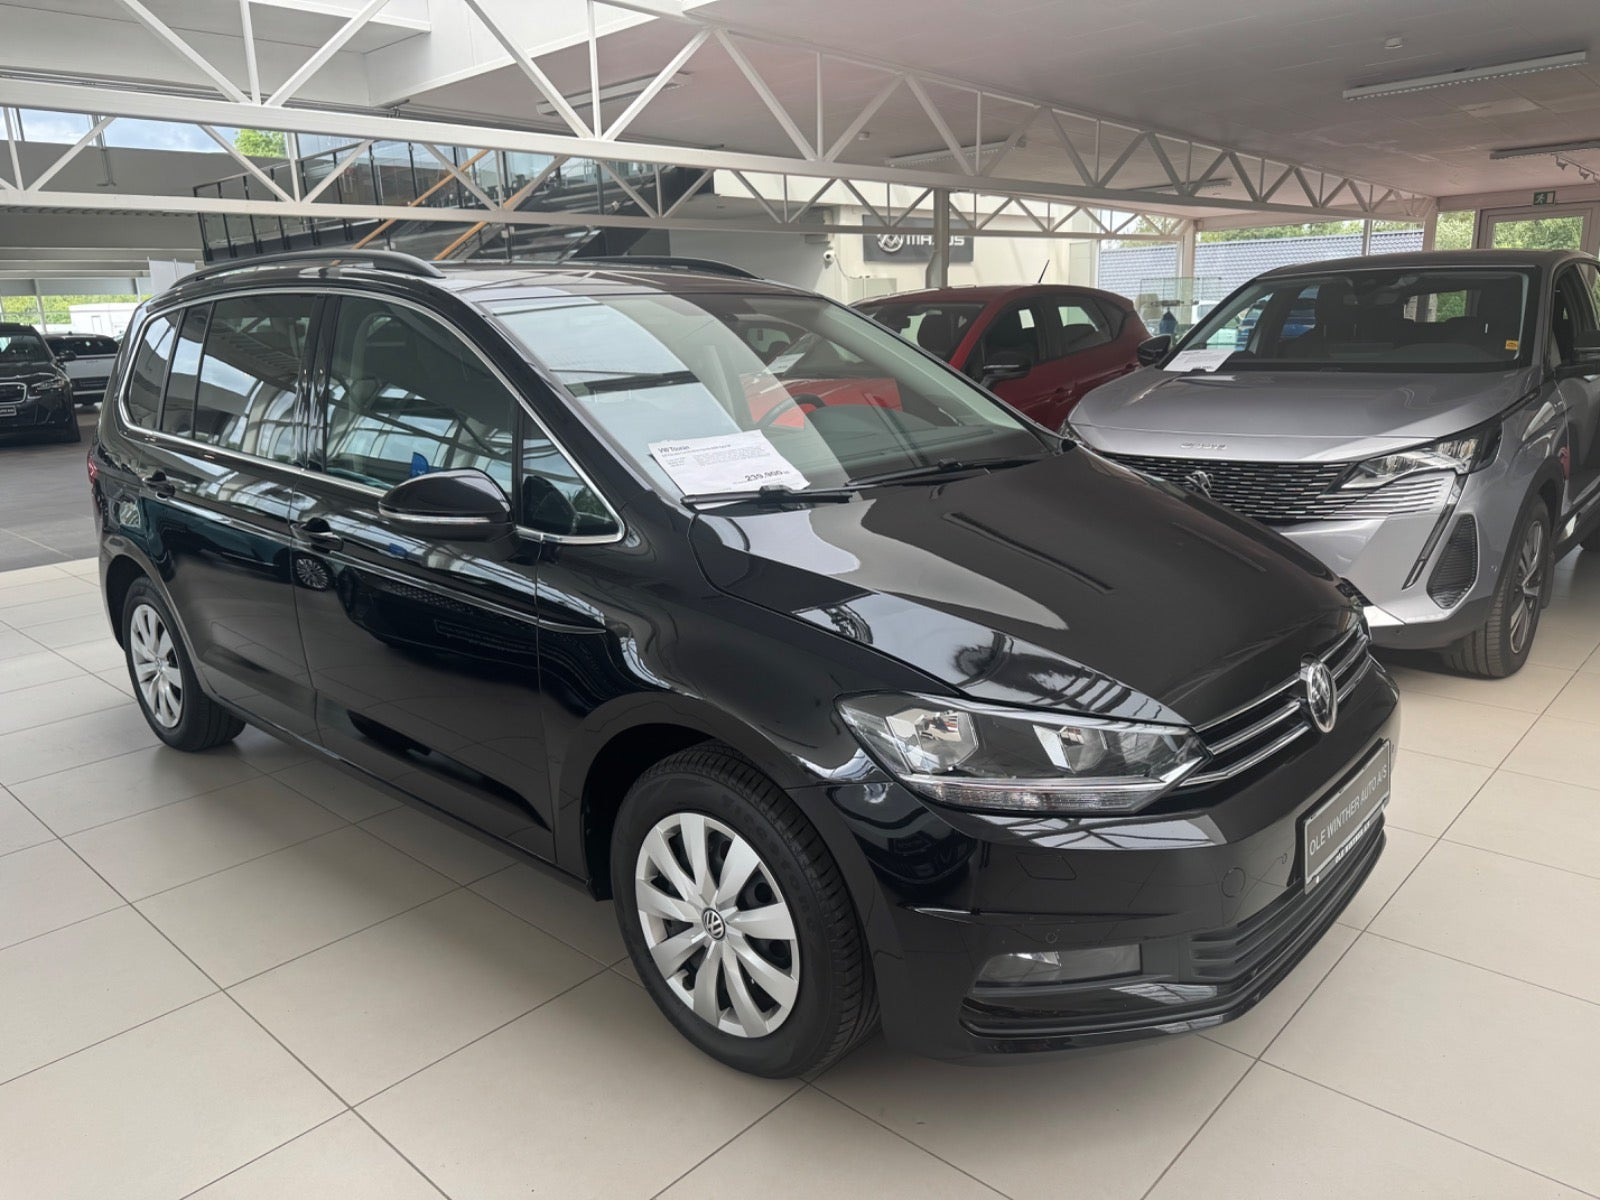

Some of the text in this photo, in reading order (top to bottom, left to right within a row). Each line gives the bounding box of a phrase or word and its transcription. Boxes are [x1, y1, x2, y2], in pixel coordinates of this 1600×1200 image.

[906, 234, 965, 246] MAS
[1309, 764, 1388, 856] OLE WINTHER AUTO A/S
